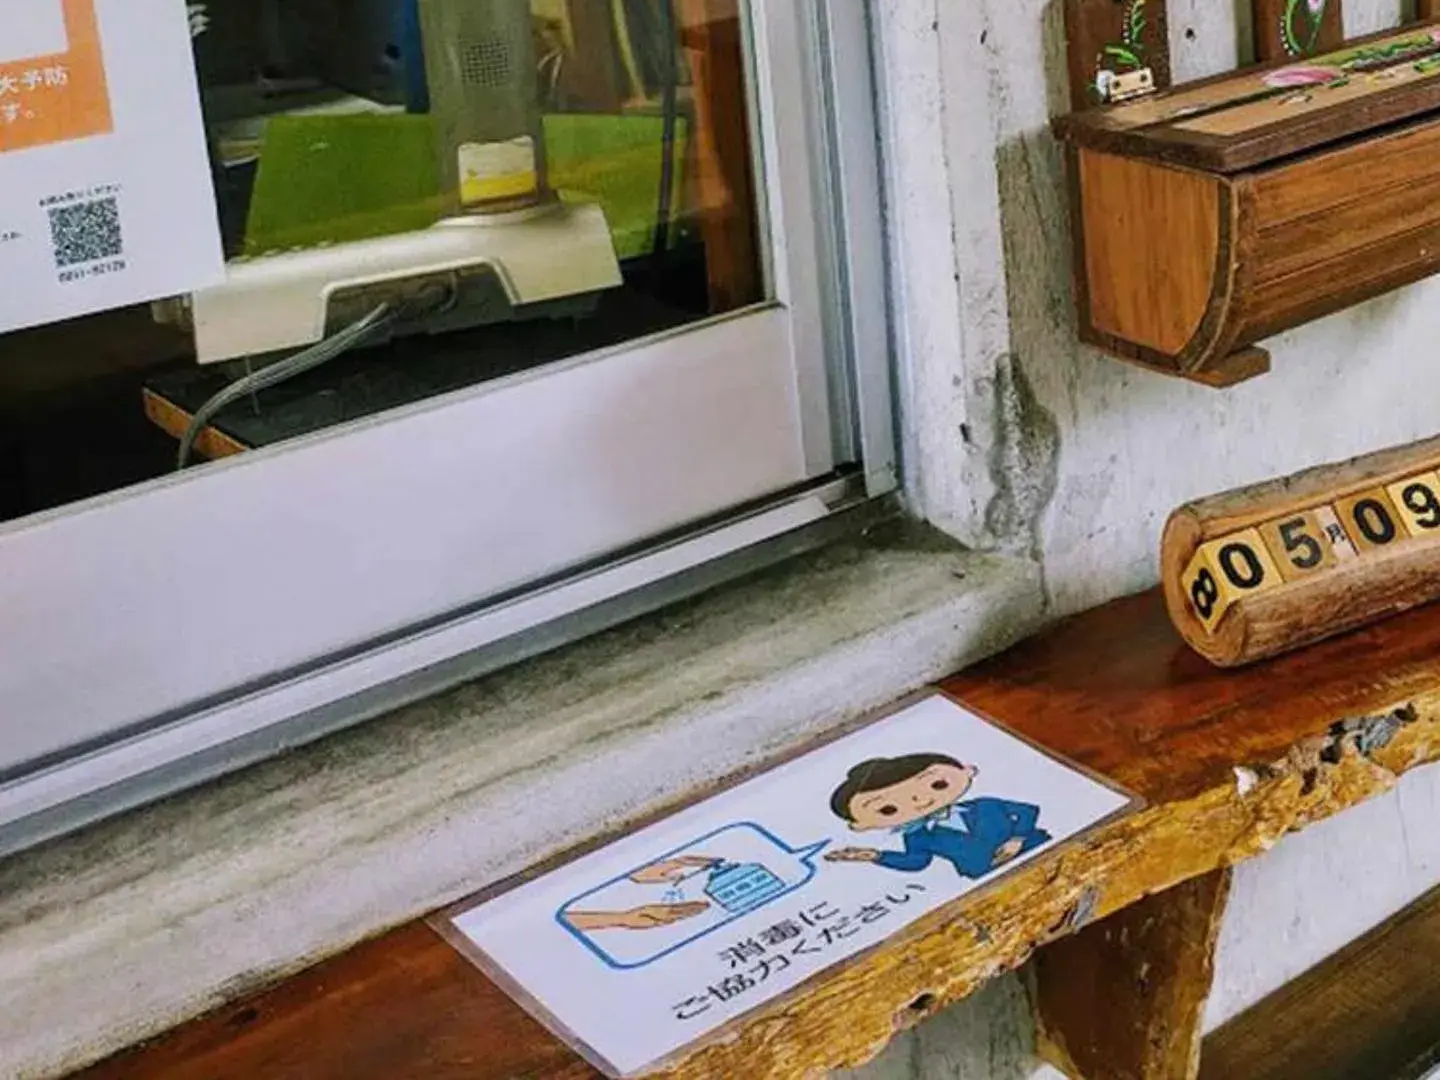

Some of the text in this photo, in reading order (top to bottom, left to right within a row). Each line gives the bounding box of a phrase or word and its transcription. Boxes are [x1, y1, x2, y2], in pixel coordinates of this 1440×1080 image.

[672, 883, 926, 1020] ご協力ください
[717, 900, 841, 968] 消毒に
